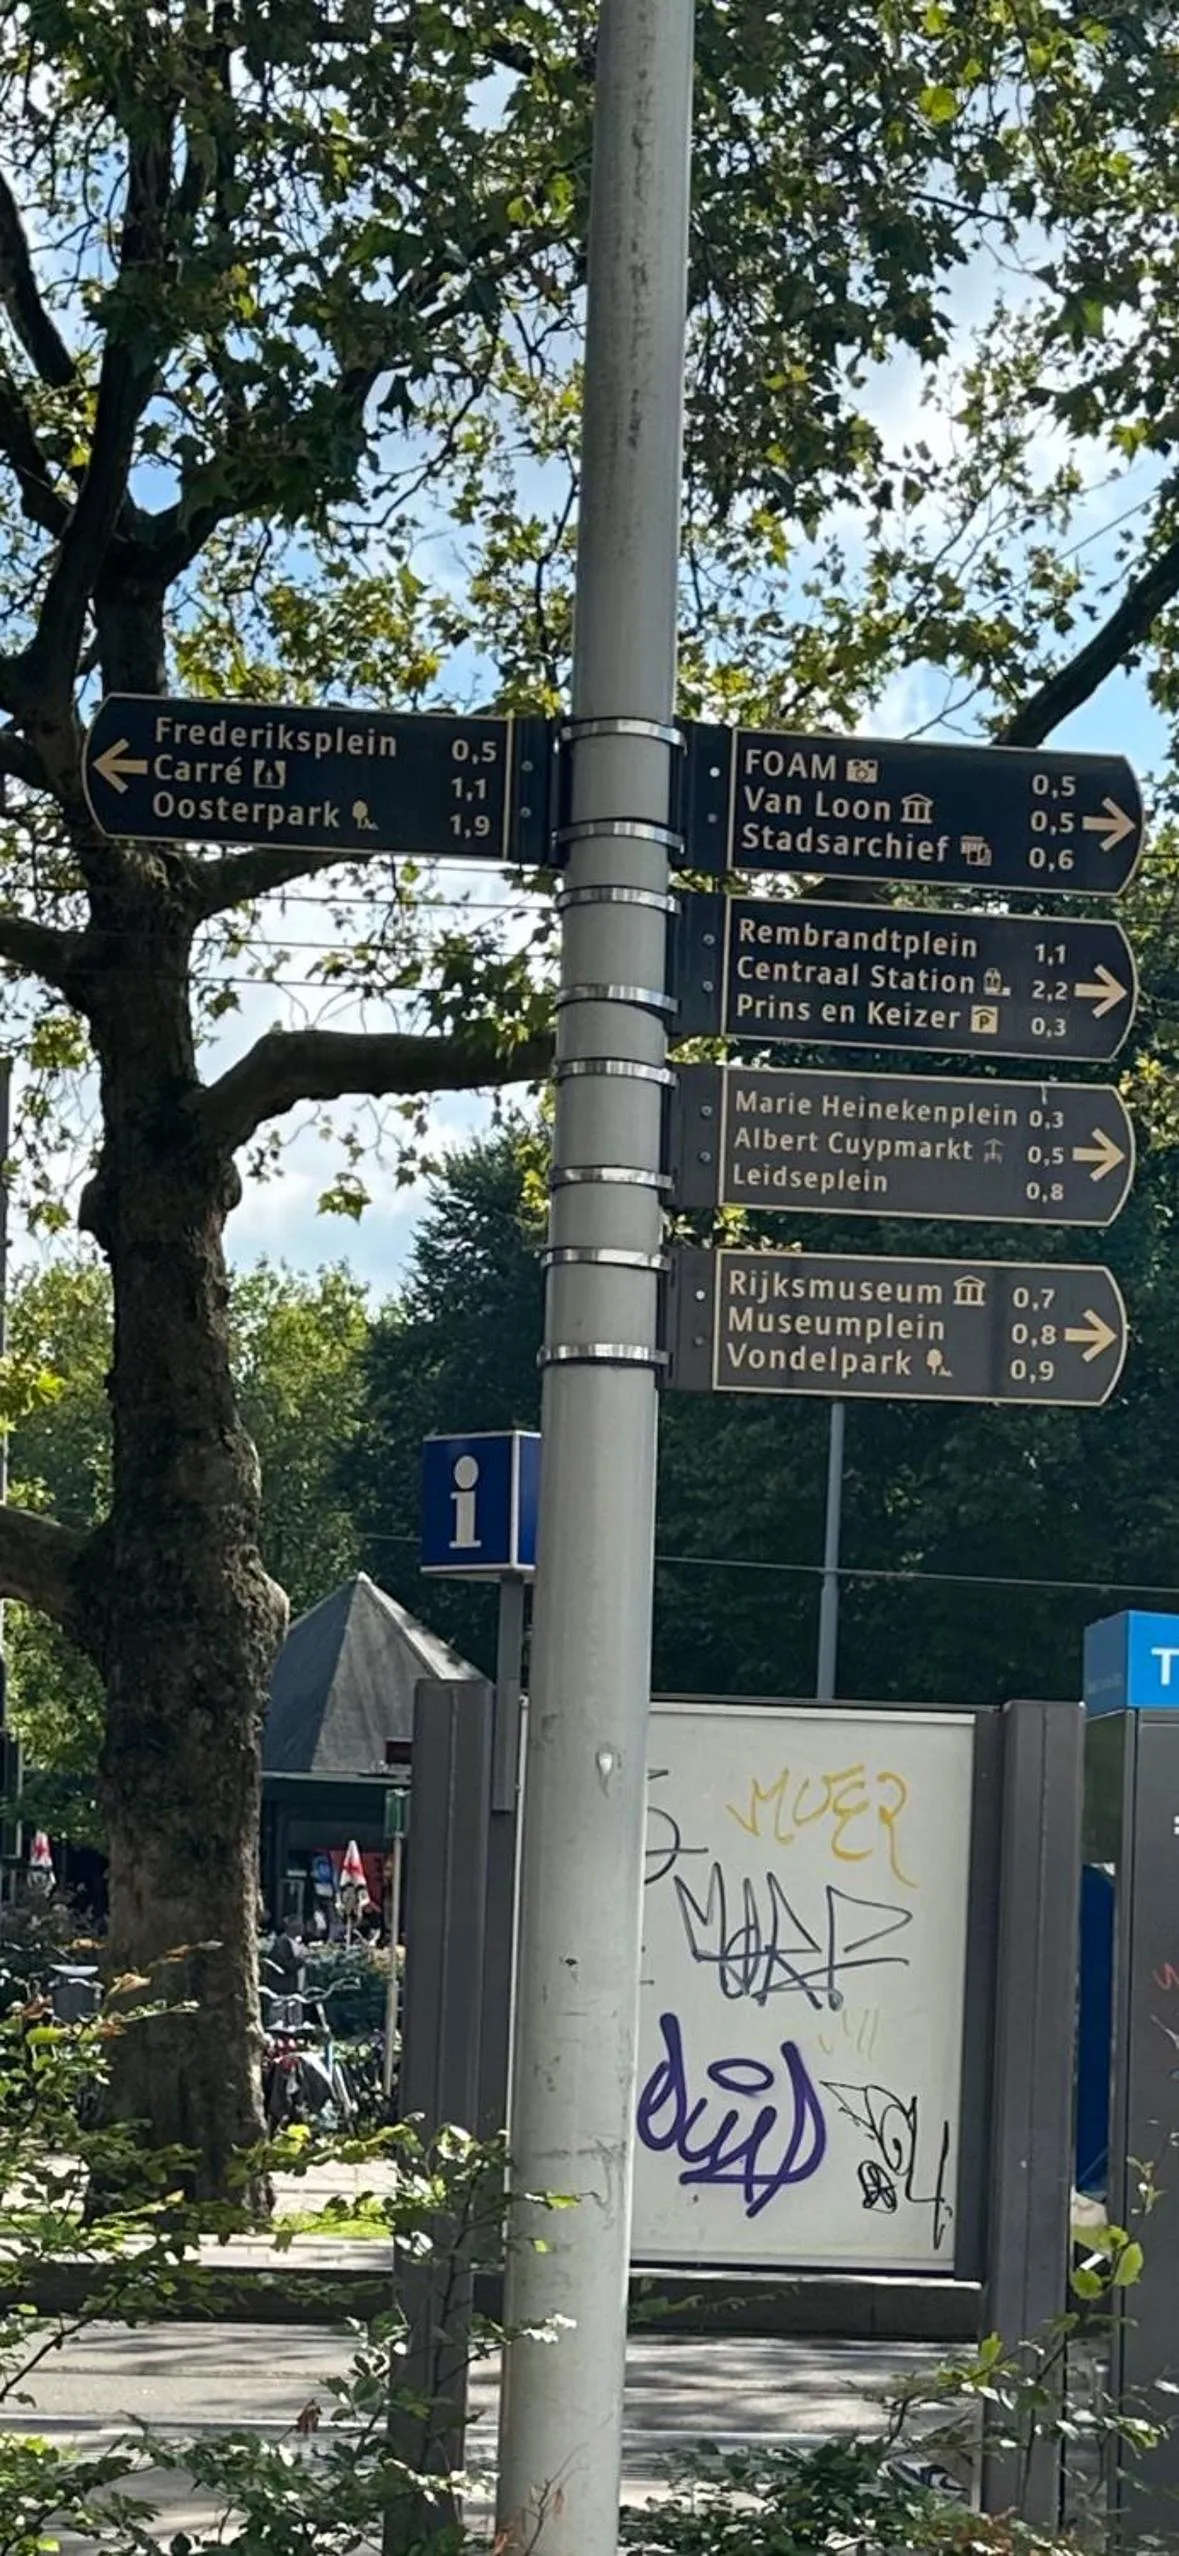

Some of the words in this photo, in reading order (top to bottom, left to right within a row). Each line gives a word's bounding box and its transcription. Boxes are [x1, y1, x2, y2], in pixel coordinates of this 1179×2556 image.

[155, 716, 397, 759] Frederiksplein
[451, 739, 497, 764] 0,5
[153, 754, 242, 785] Carré
[451, 777, 487, 801] 1,1
[745, 749, 836, 780] FOAM
[1031, 774, 1076, 798] 0,5
[153, 792, 340, 830] Oosterpark
[450, 814, 490, 838] 1,9
[744, 786, 801, 815] Van
[815, 790, 891, 823] Loon
[1030, 811, 1074, 835] 0,5
[741, 823, 950, 863] Stadsarchief
[1028, 847, 1074, 872] 0,6
[739, 919, 978, 959] Rembrandtplein
[1035, 943, 1066, 966] 1,1
[736, 956, 858, 986] Centraal
[870, 965, 974, 995] Station
[1031, 981, 1068, 1001] 2,2
[737, 993, 810, 1022] Prins
[821, 1003, 855, 1023] en
[868, 1000, 961, 1029] Keizer
[1031, 1017, 1067, 1038] 0,3
[736, 1090, 812, 1116] Marie
[821, 1095, 1018, 1128] Heinekenplein
[1029, 1110, 1064, 1130] 0,3
[734, 1127, 818, 1152] Albert
[828, 1132, 973, 1161] Cuypmarkt
[1027, 1146, 1064, 1167] 0,5
[733, 1163, 888, 1194] Leidseplein
[1026, 1181, 1064, 1202] 0,8
[729, 1270, 943, 1304] Rijksmuseum
[1012, 1288, 1055, 1312] 0,7
[728, 1307, 945, 1344] Museumplein
[1011, 1324, 1056, 1347] 0,8
[727, 1343, 912, 1379] Vondelpark
[1010, 1360, 1054, 1384] 0,9
